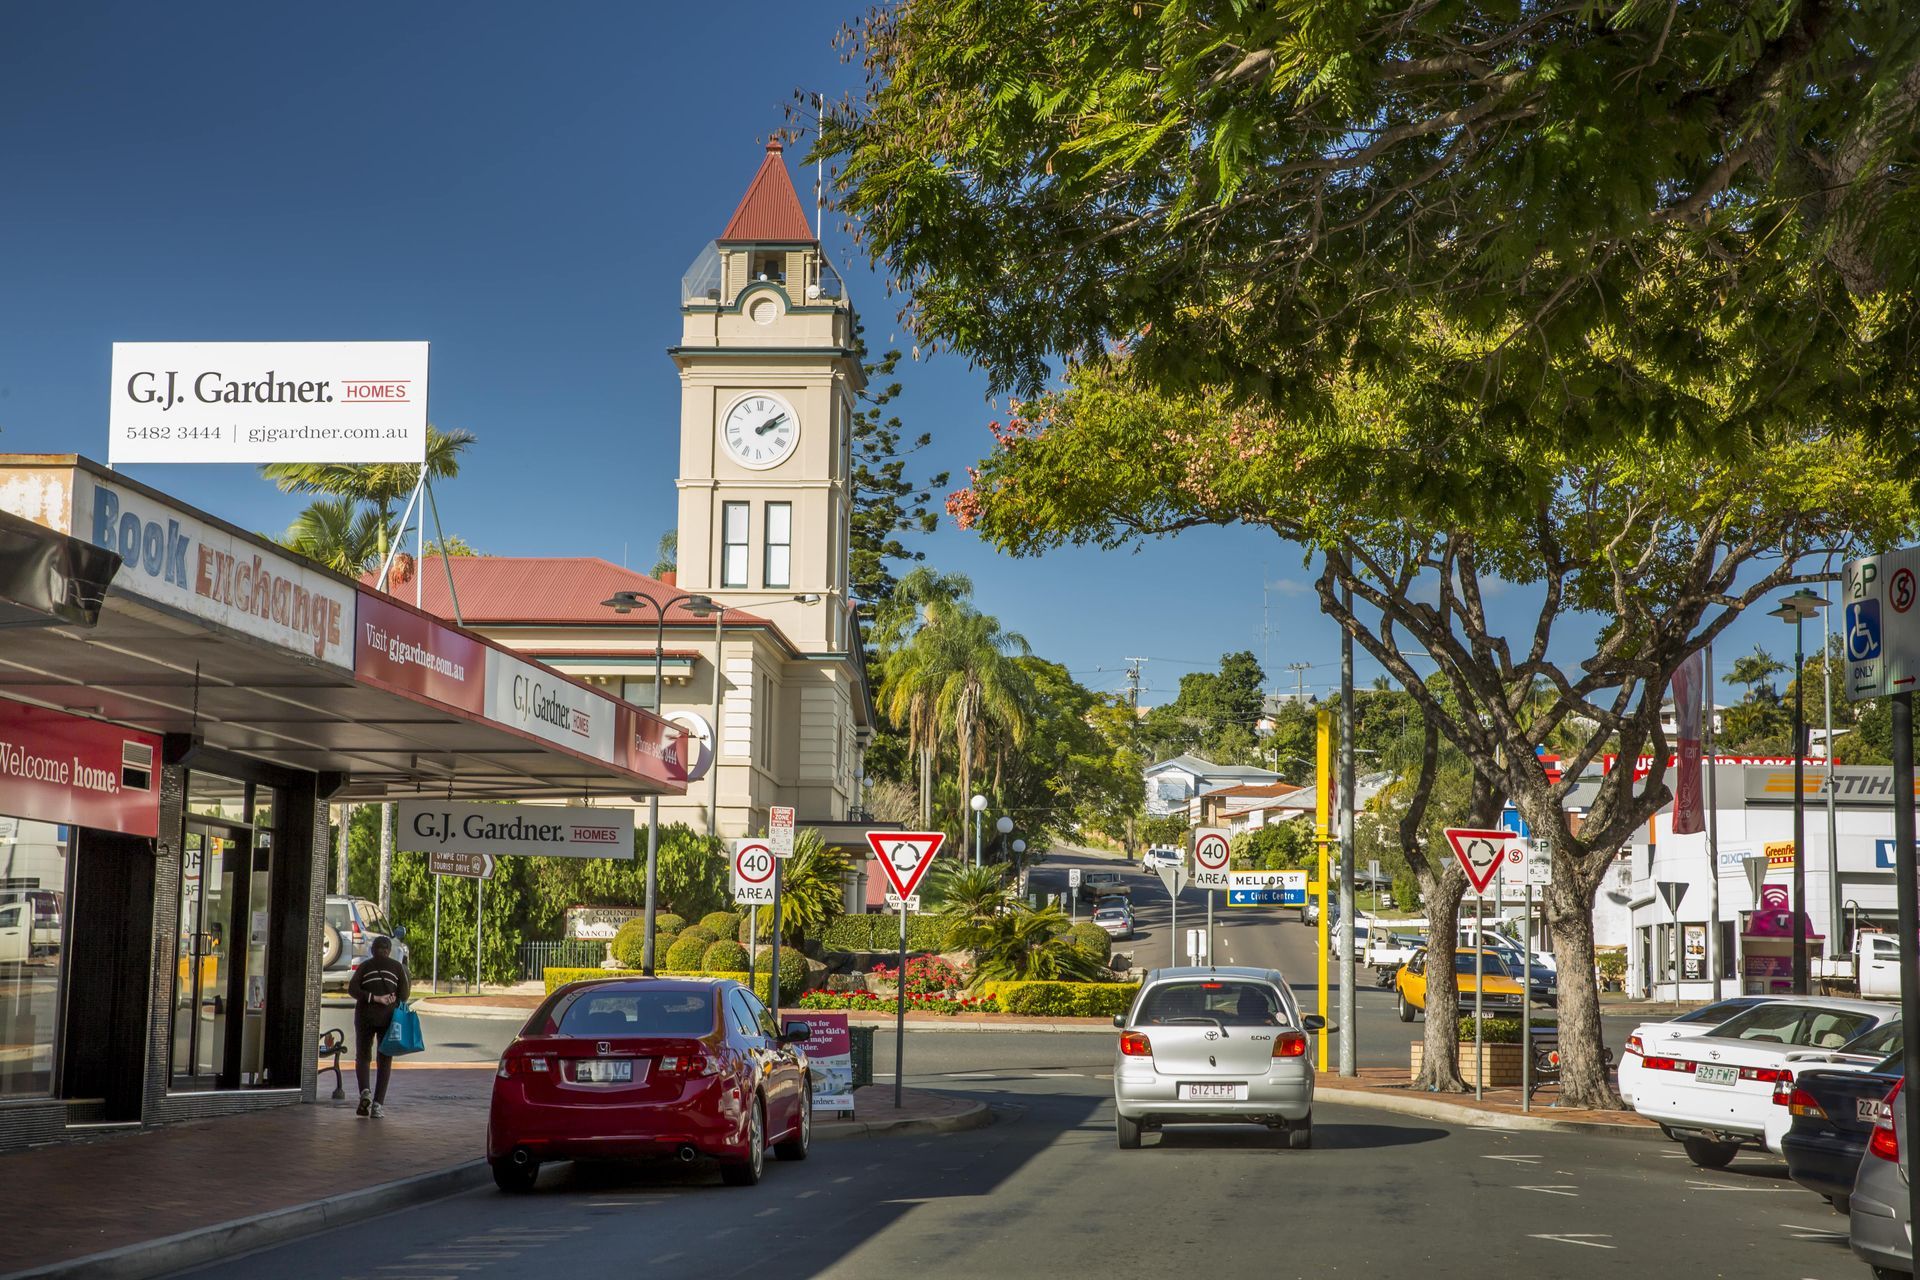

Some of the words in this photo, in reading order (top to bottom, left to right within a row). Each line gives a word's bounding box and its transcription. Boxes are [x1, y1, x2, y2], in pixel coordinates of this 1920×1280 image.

[127, 371, 184, 411] G.J.
[194, 370, 333, 403] Gardner.
[346, 385, 406, 398] HOMES
[127, 426, 171, 440] 5482
[177, 426, 222, 440] 3444
[248, 425, 408, 443] gjgardner.com.au
[92, 485, 190, 590] Book
[365, 623, 388, 652] Visit
[389, 639, 464, 682] gjgardner.com.au
[1855, 665, 1875, 679] ONLY
[513, 674, 531, 722] G.J.
[532, 683, 571, 730] Gardner.
[573, 713, 590, 734] HOMES
[0, 742, 69, 784] Welcome
[73, 757, 119, 794] home.
[413, 812, 456, 843] G.J.
[463, 814, 565, 842] Gardner.
[574, 829, 617, 841] HOMES
[456, 854, 468, 862] CITY
[1202, 843, 1224, 859] 40
[433, 861, 454, 871] TOURIST
[455, 864, 470, 873] DRIVE
[744, 855, 768, 872] 40
[1197, 873, 1228, 884] AREA
[1236, 876, 1284, 886] MELLOR
[1289, 875, 1299, 883] ST
[737, 888, 773, 899] AREA
[1251, 891, 1268, 900] Civic
[1272, 891, 1294, 900] Centre
[810, 1036, 833, 1044] major
